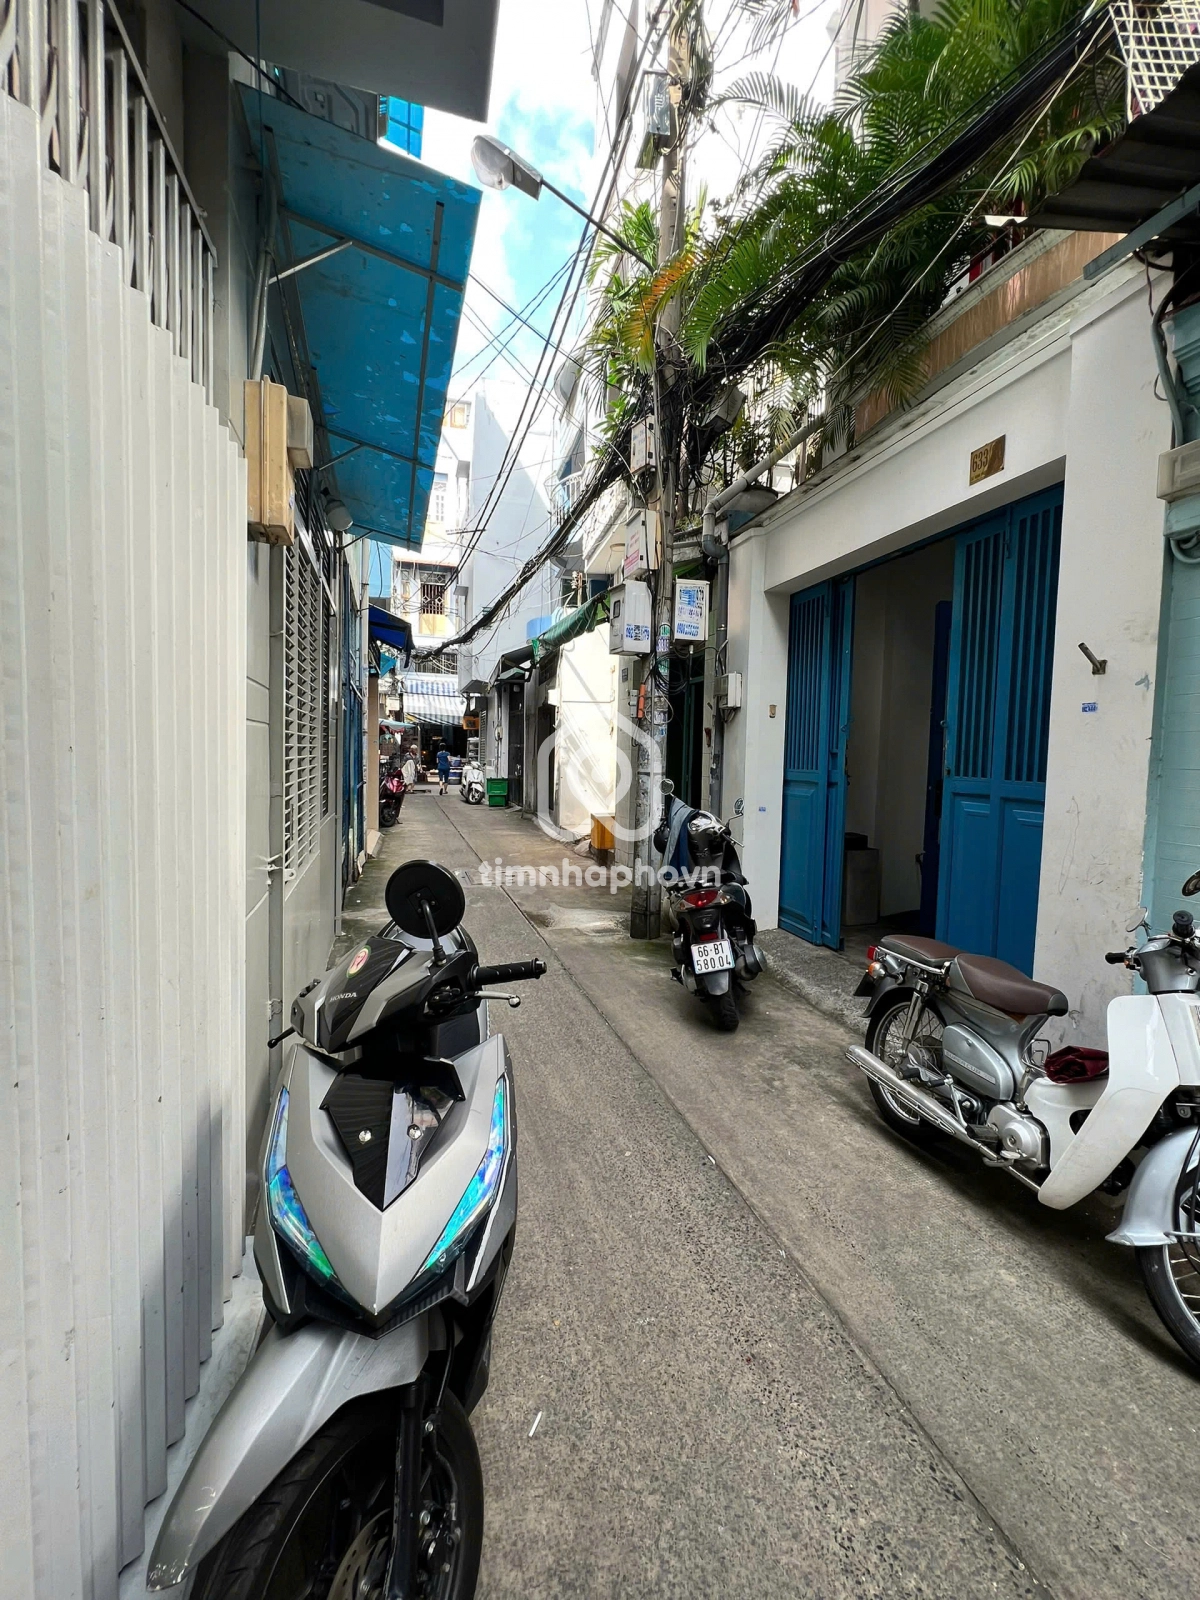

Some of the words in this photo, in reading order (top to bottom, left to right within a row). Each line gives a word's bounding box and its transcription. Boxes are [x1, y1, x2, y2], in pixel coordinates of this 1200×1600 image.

[697, 943, 724, 957] 66-B1
[696, 955, 731, 971] 580.04
[330, 992, 357, 1002] HONDA
